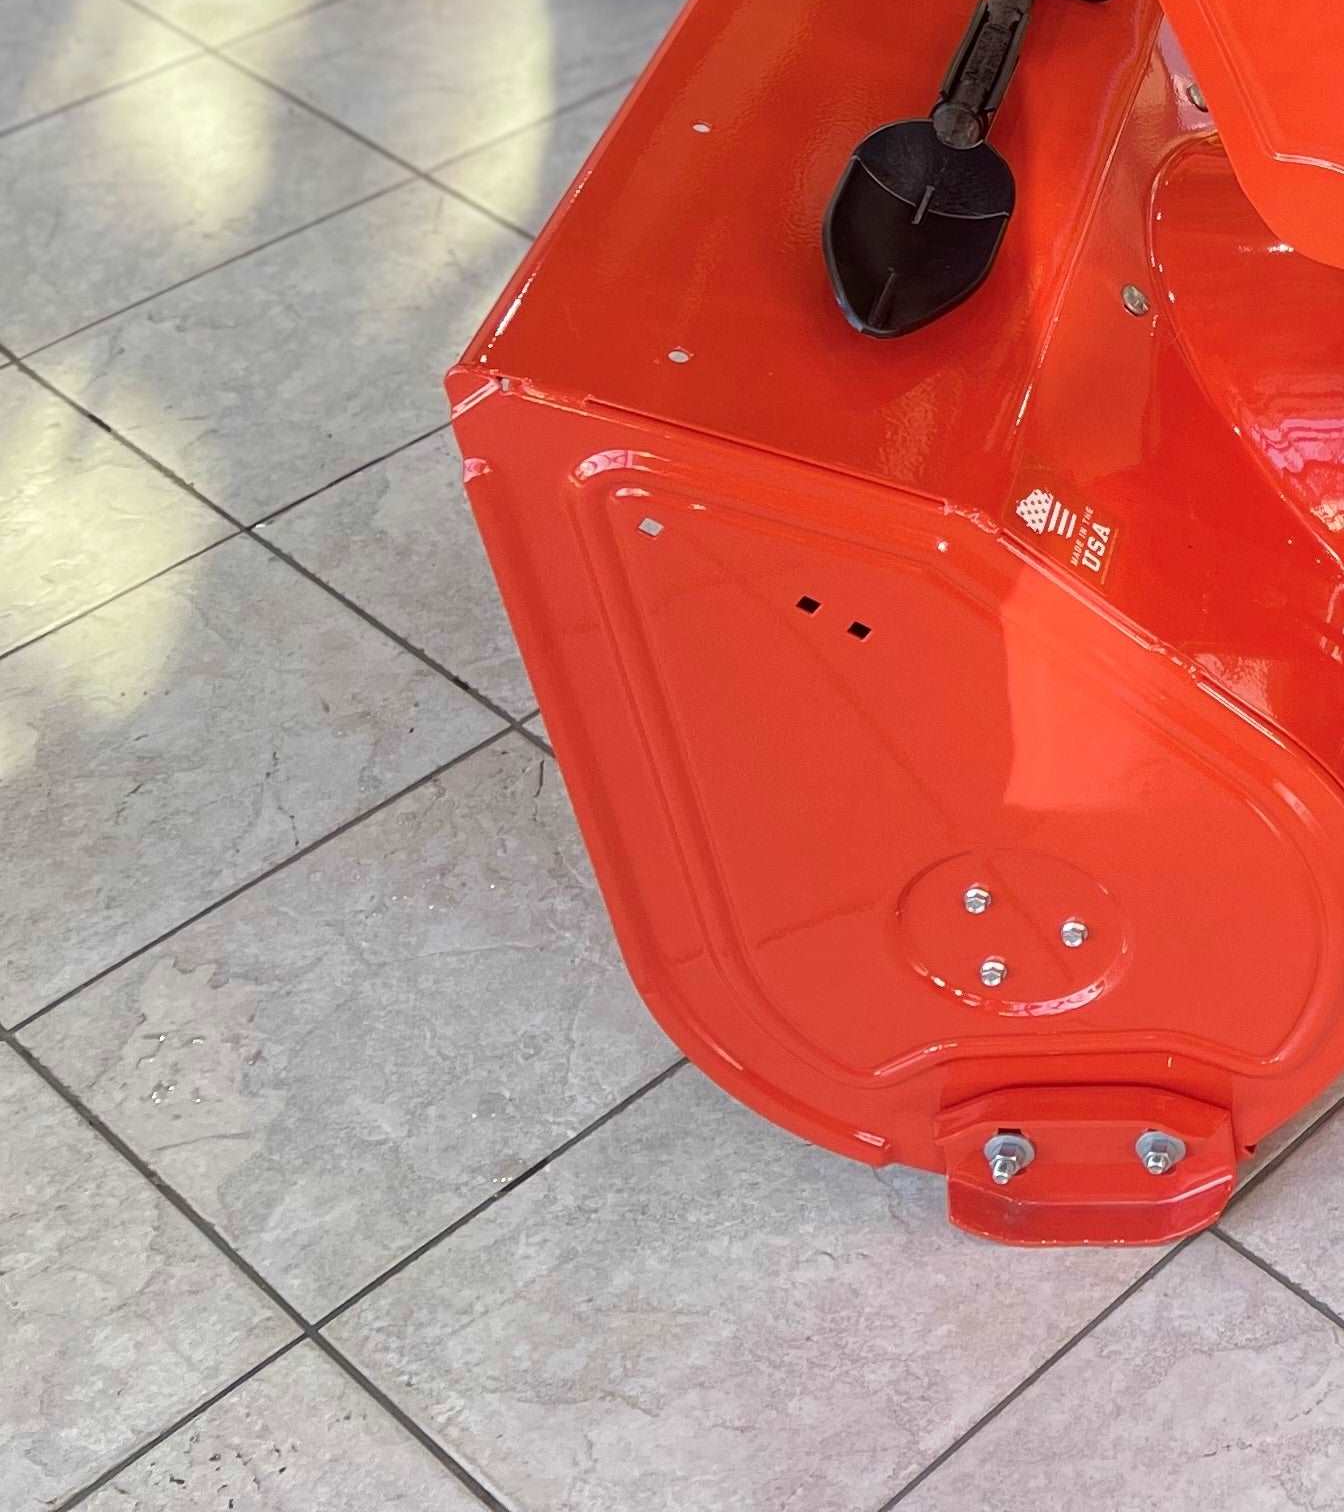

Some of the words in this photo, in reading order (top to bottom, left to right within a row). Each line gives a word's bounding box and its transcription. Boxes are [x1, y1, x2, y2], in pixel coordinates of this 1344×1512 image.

[1081, 505, 1095, 526] THE
[1078, 526, 1089, 540] IN
[1069, 538, 1086, 567] MADE
[1081, 522, 1111, 573] USA
